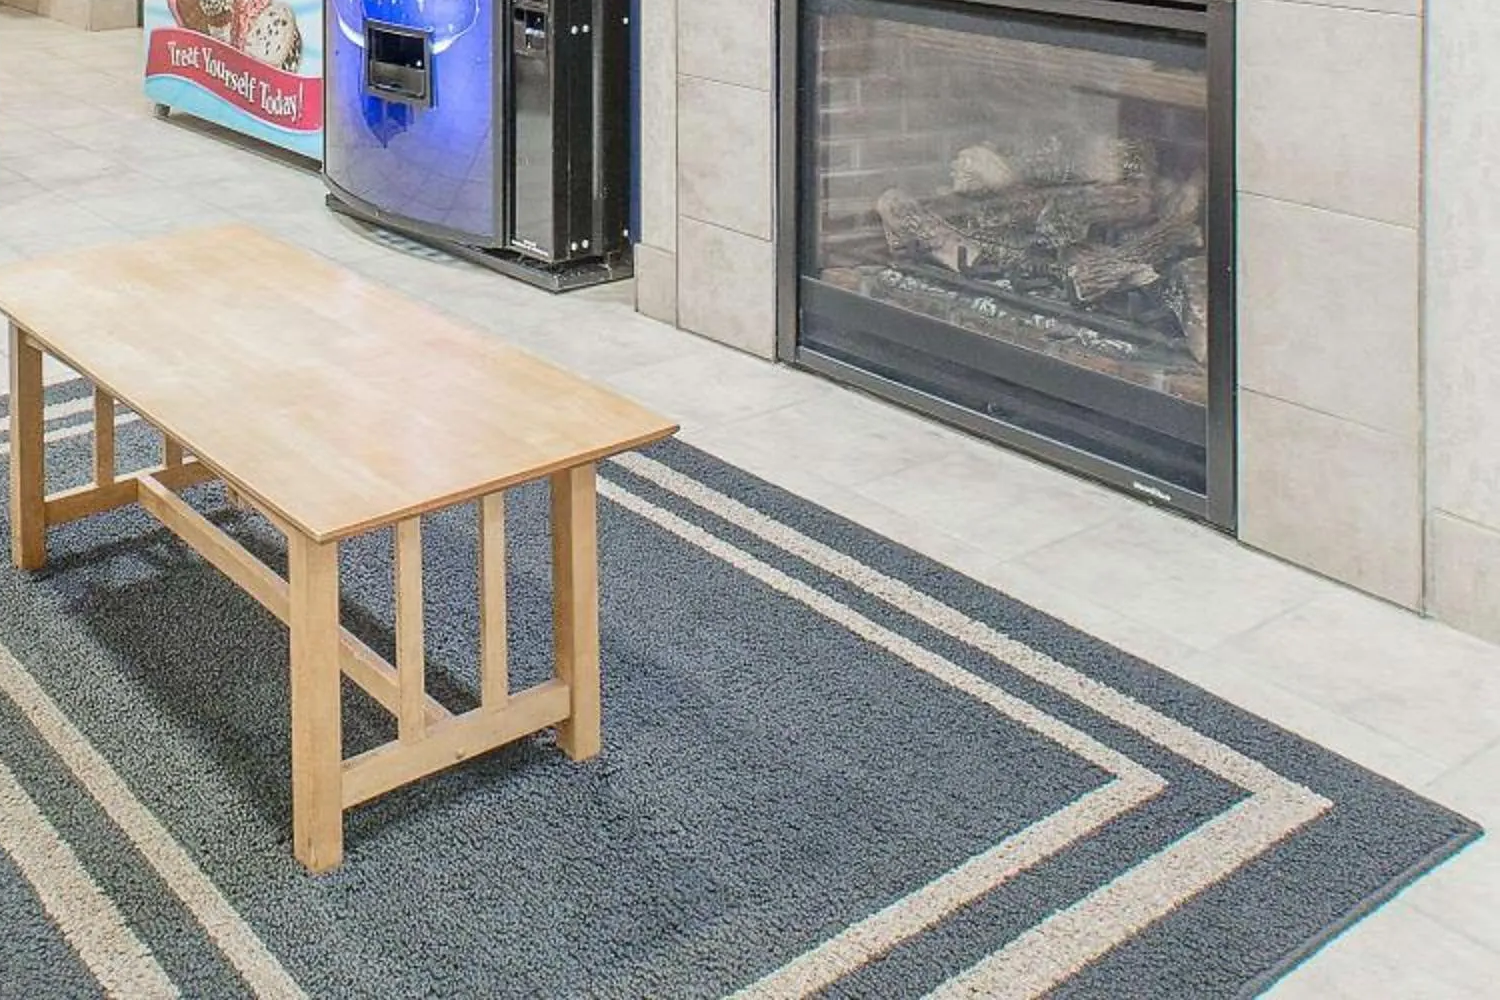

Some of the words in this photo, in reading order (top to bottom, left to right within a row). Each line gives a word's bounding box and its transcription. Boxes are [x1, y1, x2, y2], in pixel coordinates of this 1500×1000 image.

[167, 41, 199, 68] Treat
[202, 47, 256, 103] Yourself
[260, 80, 303, 122] Today!
